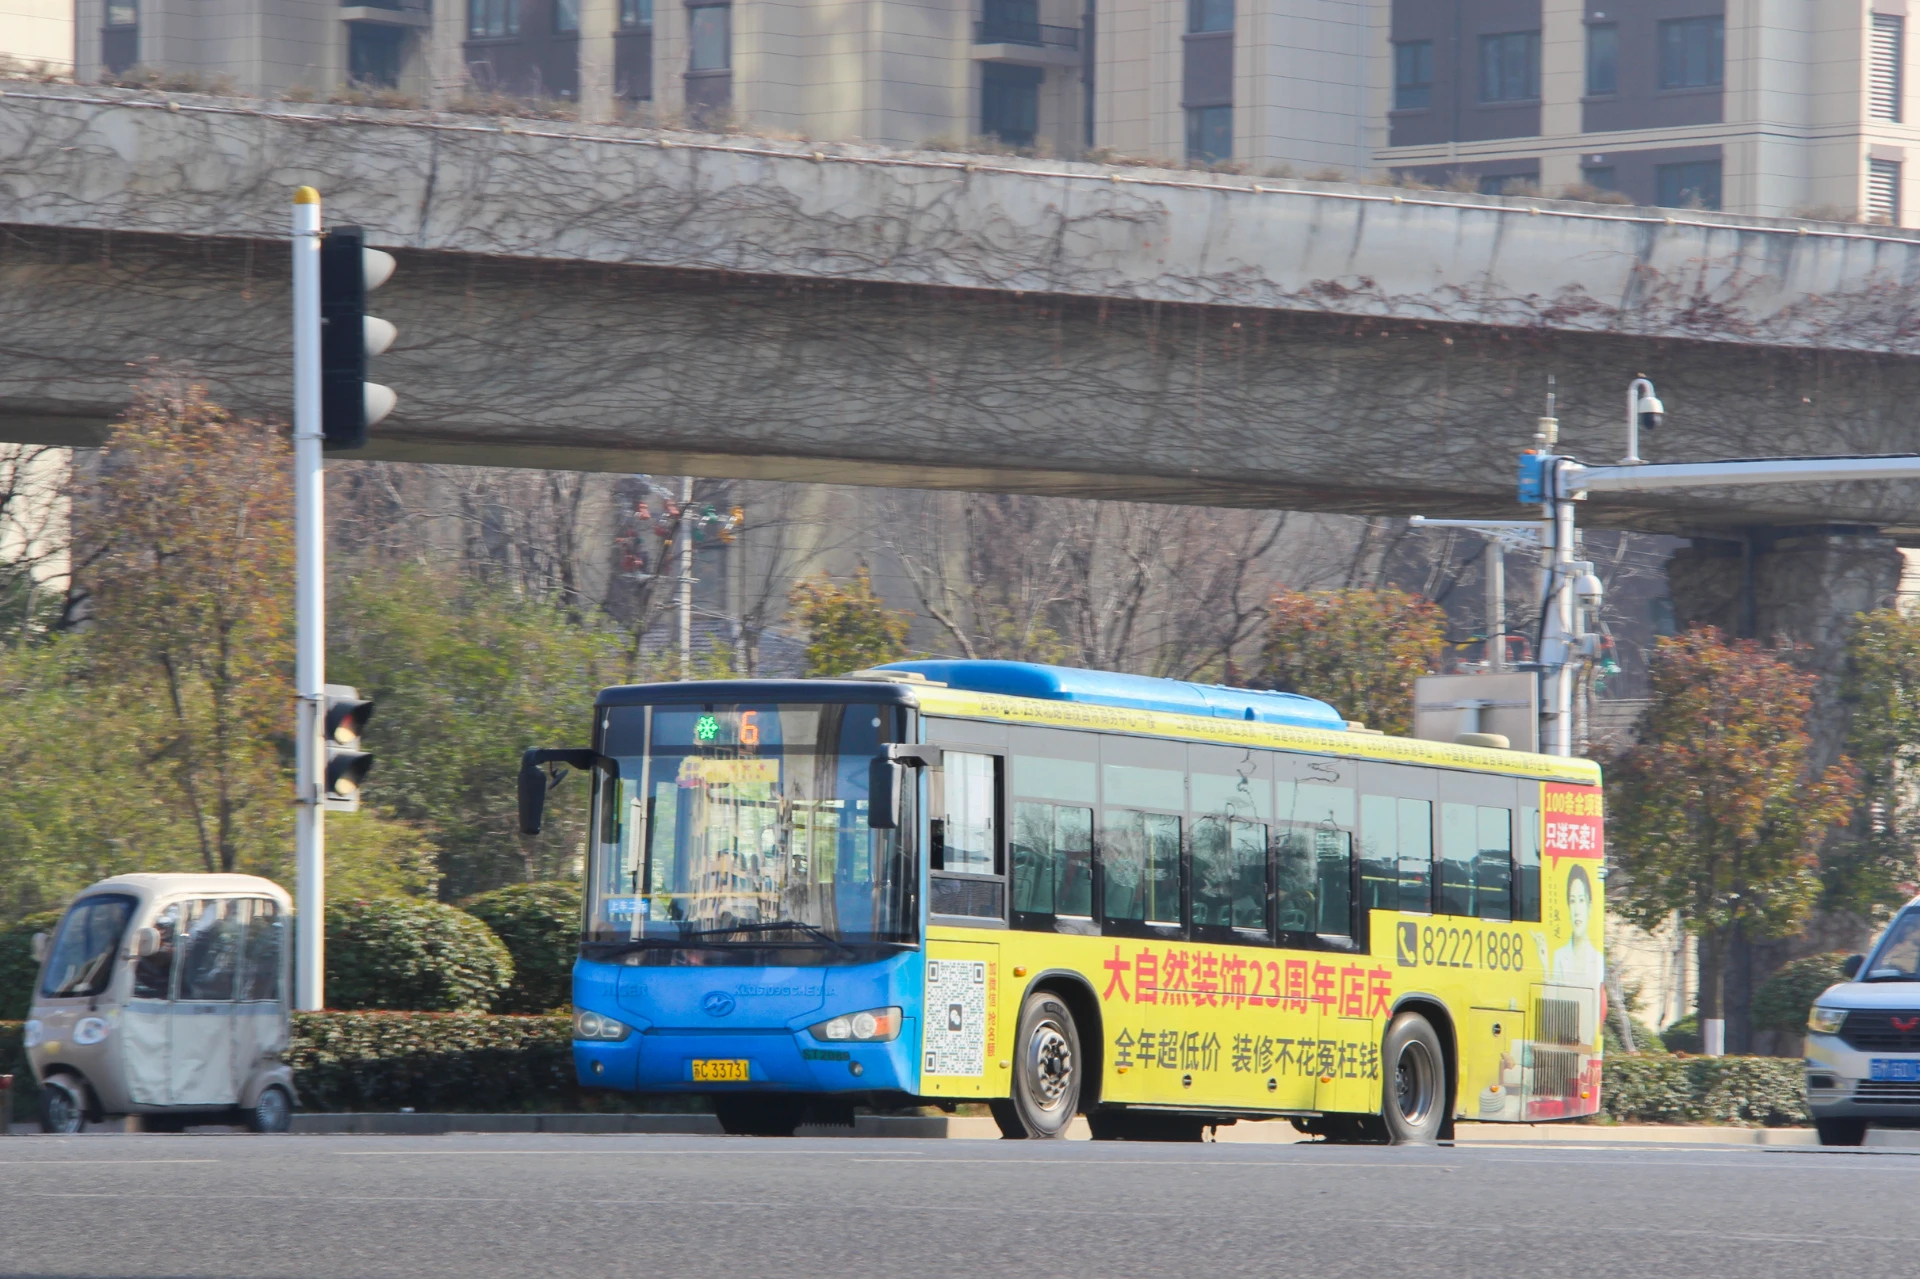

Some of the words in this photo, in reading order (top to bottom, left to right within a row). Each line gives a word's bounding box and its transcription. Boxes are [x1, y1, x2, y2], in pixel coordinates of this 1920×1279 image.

[740, 710, 759, 744] 6
[1423, 926, 1524, 972] 82221888
[1102, 944, 1393, 1020] 大自然装饰23周年店庆
[1114, 1027, 1221, 1072] 全年超低价
[1231, 1033, 1380, 1081] 装修不花冤枉钱
